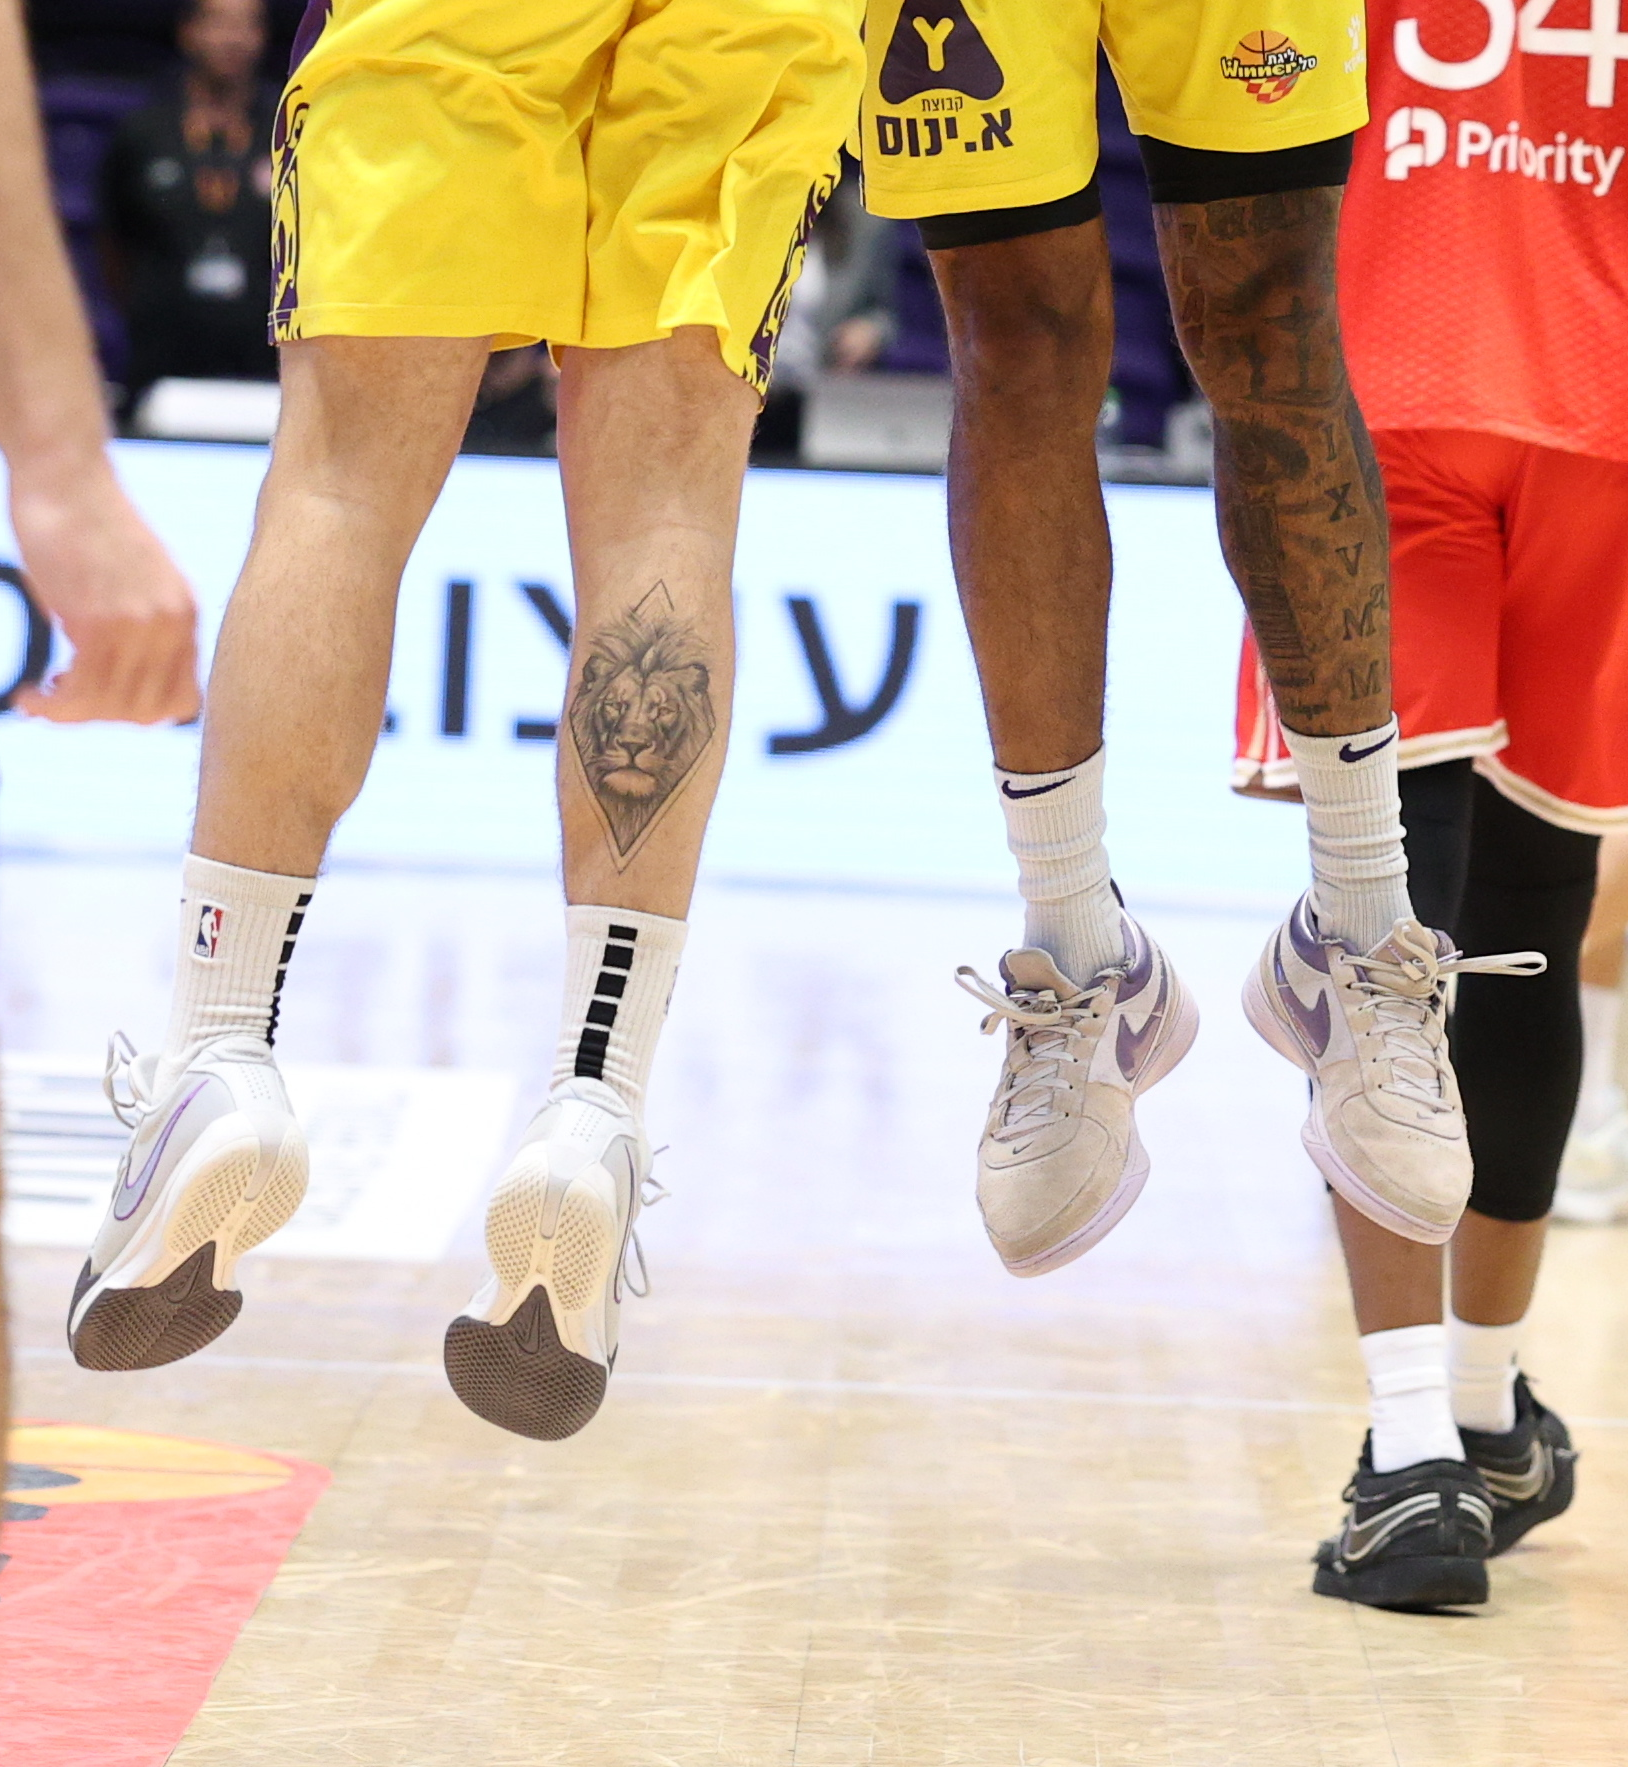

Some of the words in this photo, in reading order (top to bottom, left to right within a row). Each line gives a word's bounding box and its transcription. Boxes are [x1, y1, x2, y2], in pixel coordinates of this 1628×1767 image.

[1266, 46, 1297, 66] ליגת
[1297, 55, 1318, 73] סל
[1221, 57, 1298, 79] Winner
[921, 96, 964, 113] קבוצת
[876, 108, 1014, 157] א.ינוס
[1456, 116, 1625, 197] Priority
